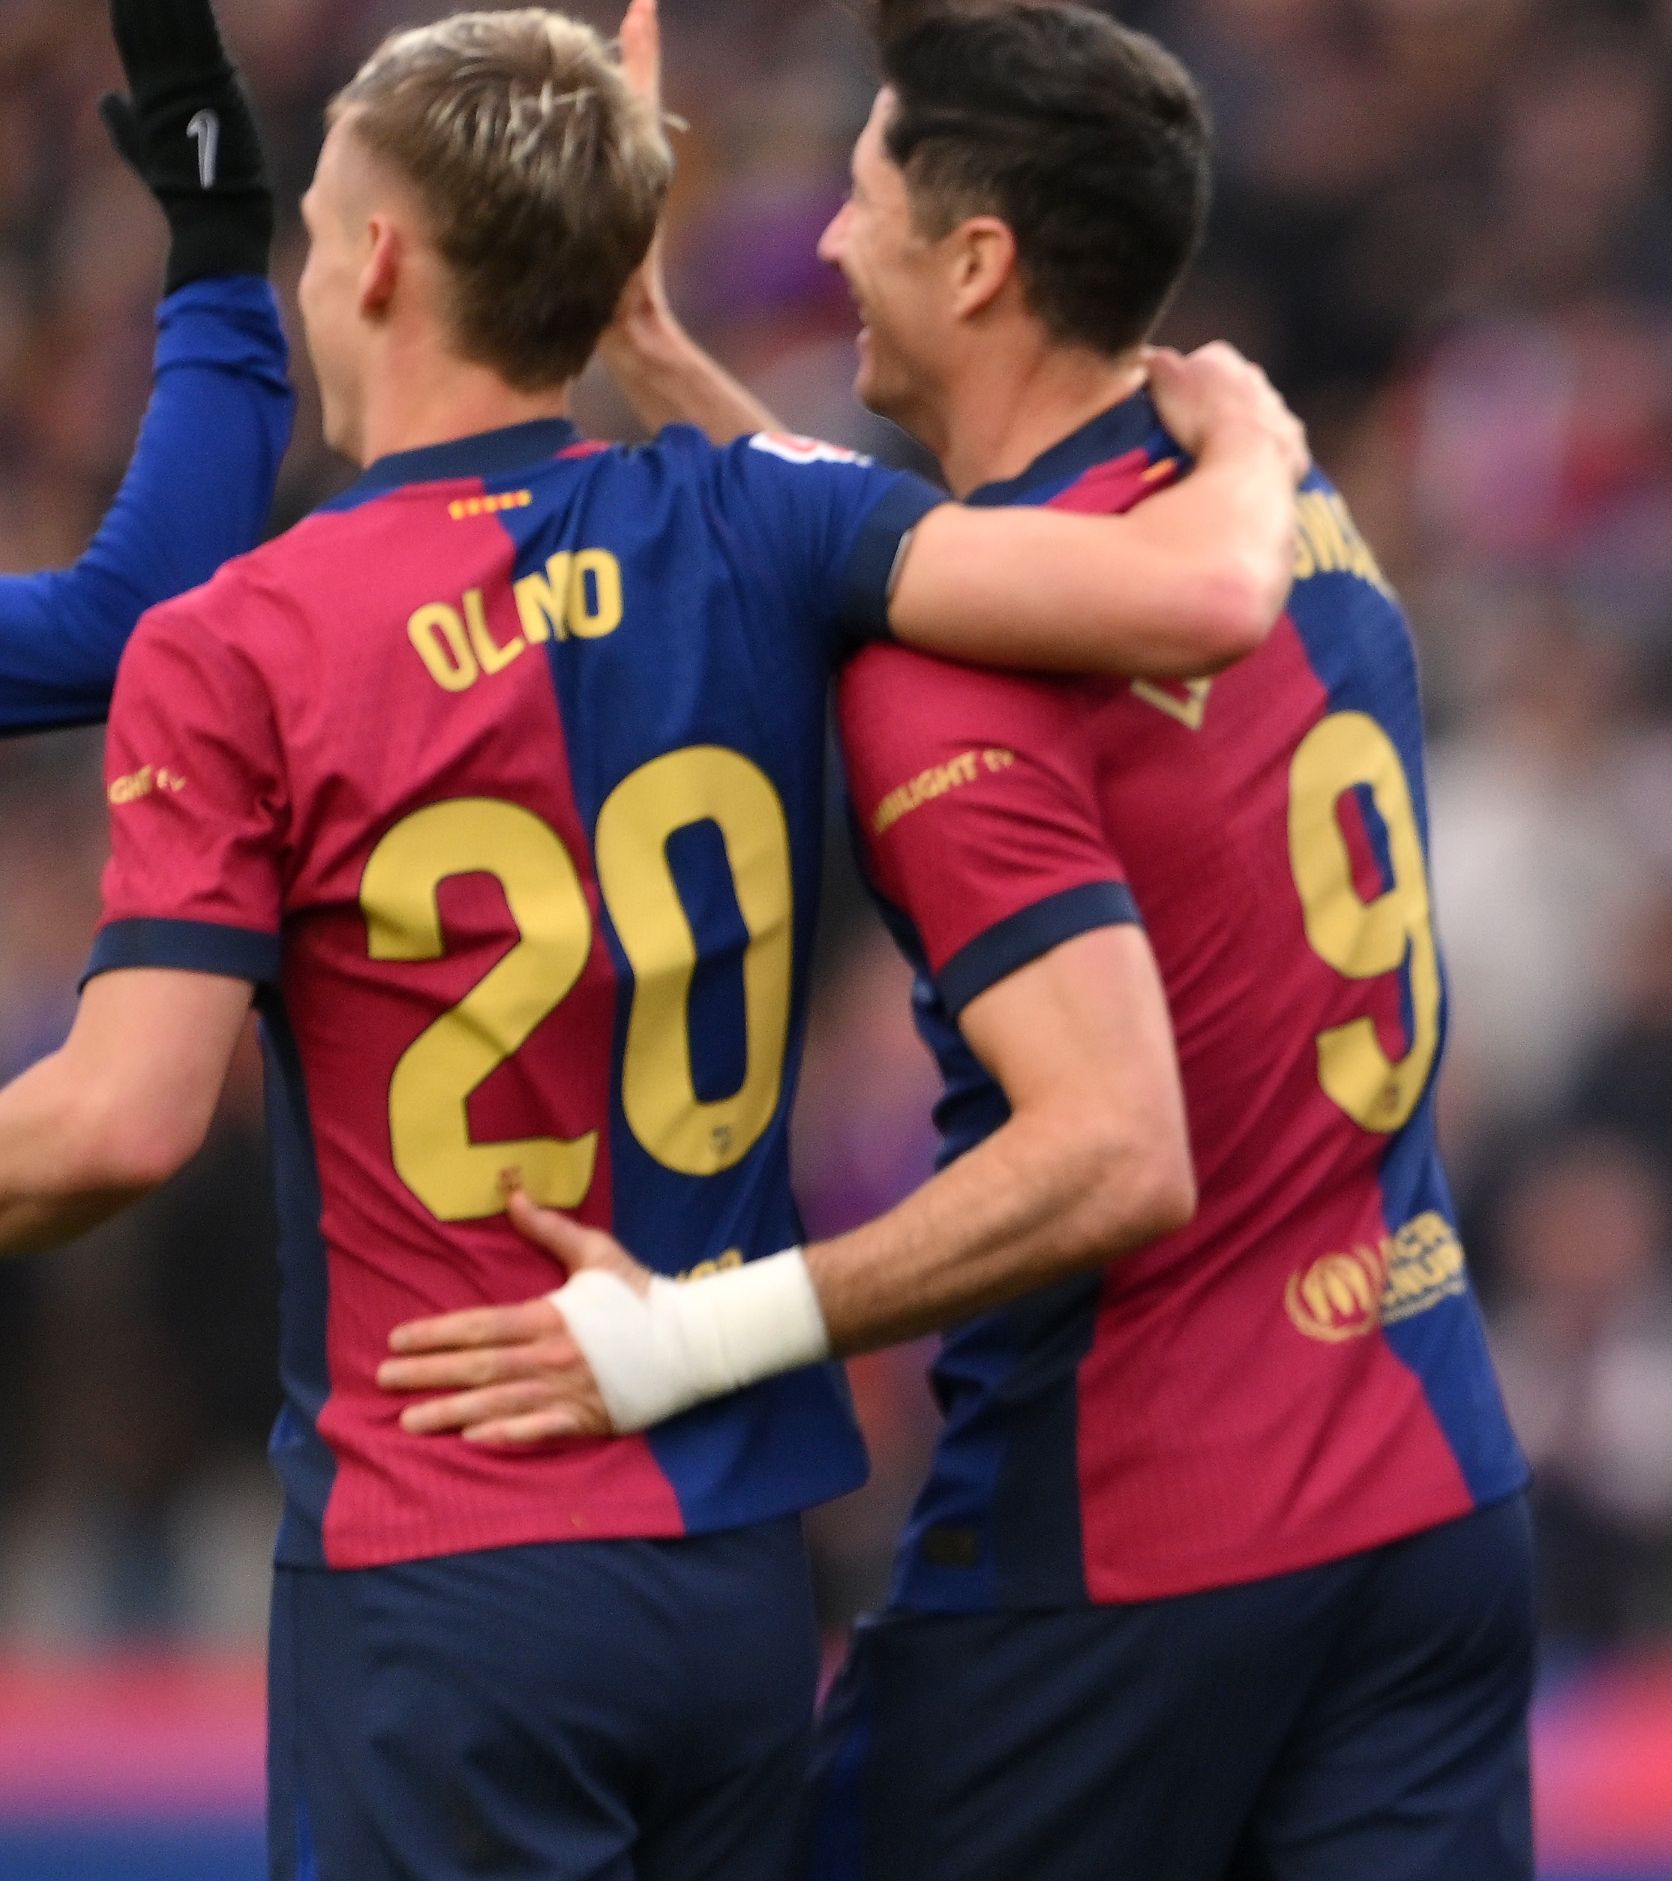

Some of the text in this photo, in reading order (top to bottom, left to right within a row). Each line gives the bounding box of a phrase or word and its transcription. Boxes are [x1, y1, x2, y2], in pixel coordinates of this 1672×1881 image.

[406, 546, 624, 693] OLMO
[359, 745, 794, 1222] 20
[1287, 711, 1445, 1134] 9
